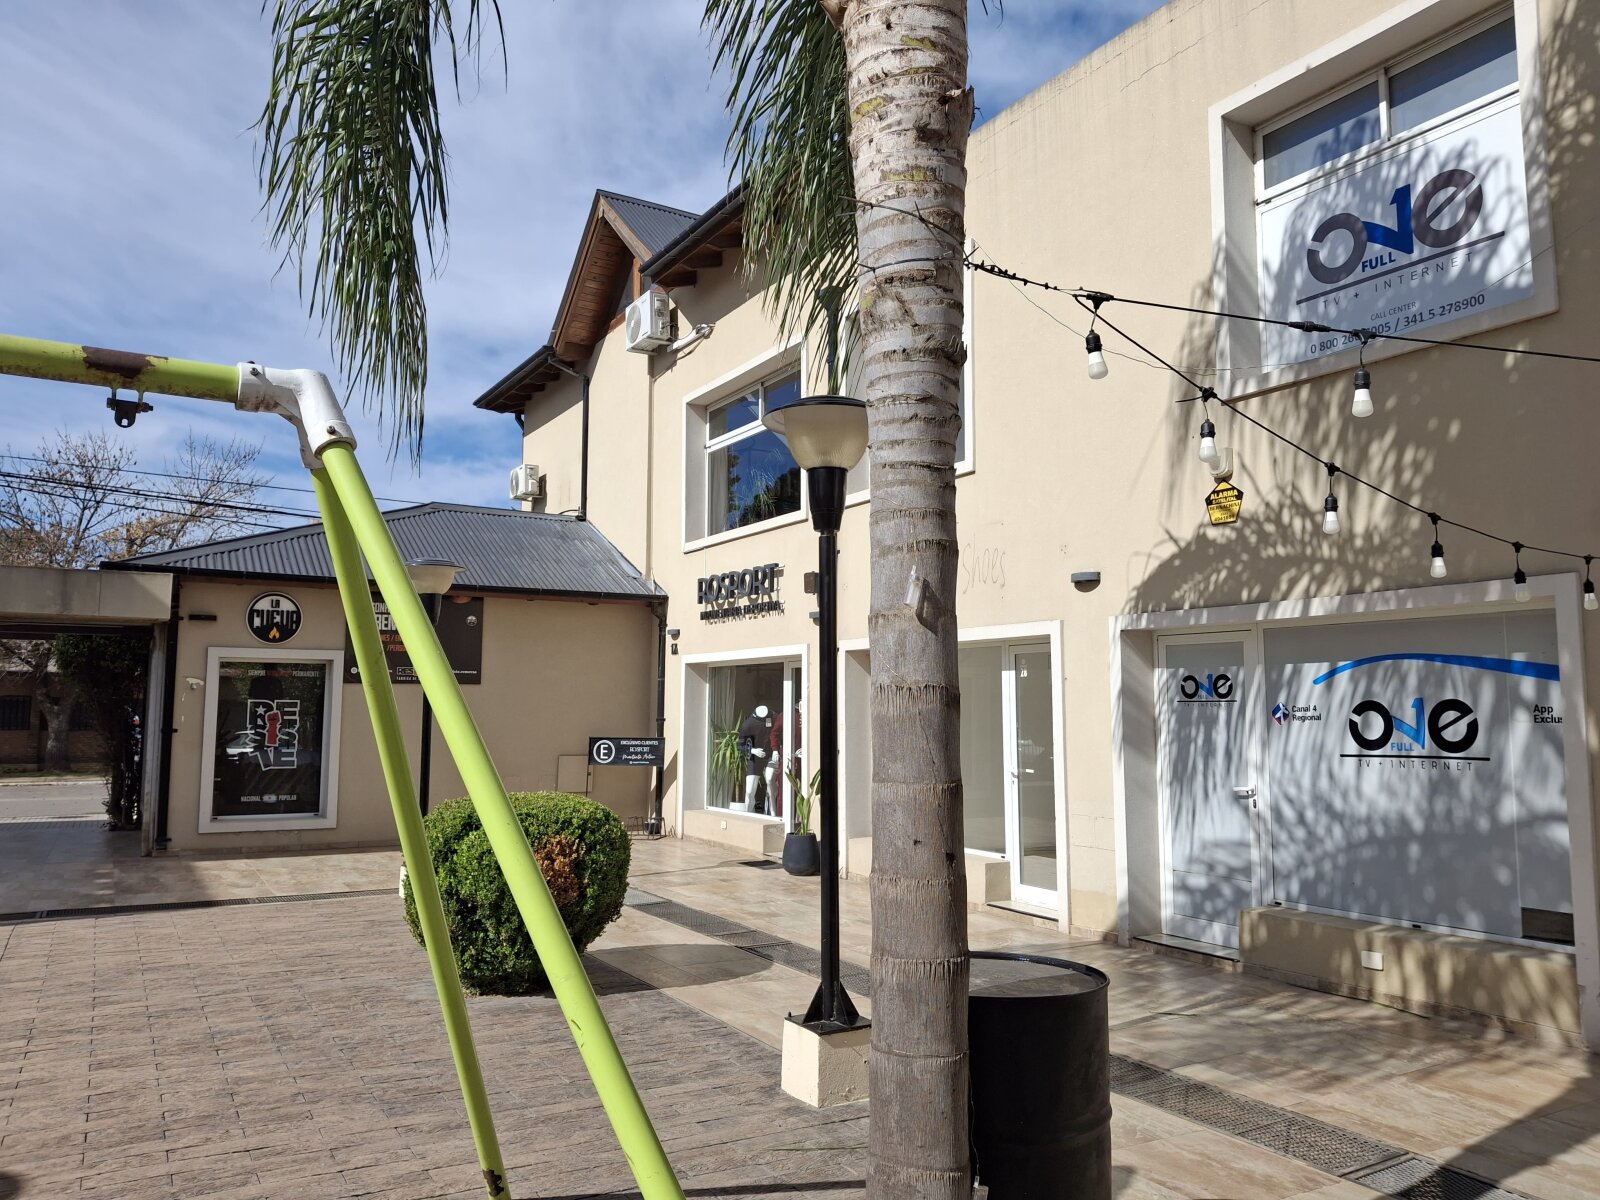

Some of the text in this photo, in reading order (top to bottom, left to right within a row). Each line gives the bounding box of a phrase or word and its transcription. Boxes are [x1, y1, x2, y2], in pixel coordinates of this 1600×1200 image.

[1361, 251, 1397, 273] FULL
[1322, 295, 1341, 309] TV
[1374, 251, 1474, 293] INTERNET
[1370, 301, 1417, 321] CALL CENTER
[1310, 343, 1317, 354] 0
[1319, 337, 1339, 352] 800
[1403, 311, 1428, 327] 341
[1428, 308, 1436, 320] 5
[1438, 293, 1486, 317] 278900
[1210, 489, 1238, 499] ALARMA
[697, 562, 780, 605] ROSPORT
[270, 599, 281, 609] LA
[252, 609, 299, 631] CUEVA
[1291, 704, 1318, 713] Canal 4
[1533, 704, 1554, 716] App
[1292, 713, 1322, 723] Regional
[600, 744, 609, 759] E
[1390, 742, 1415, 752] FULL
[1358, 759, 1371, 768] TV
[1390, 759, 1473, 772] INTERNET
